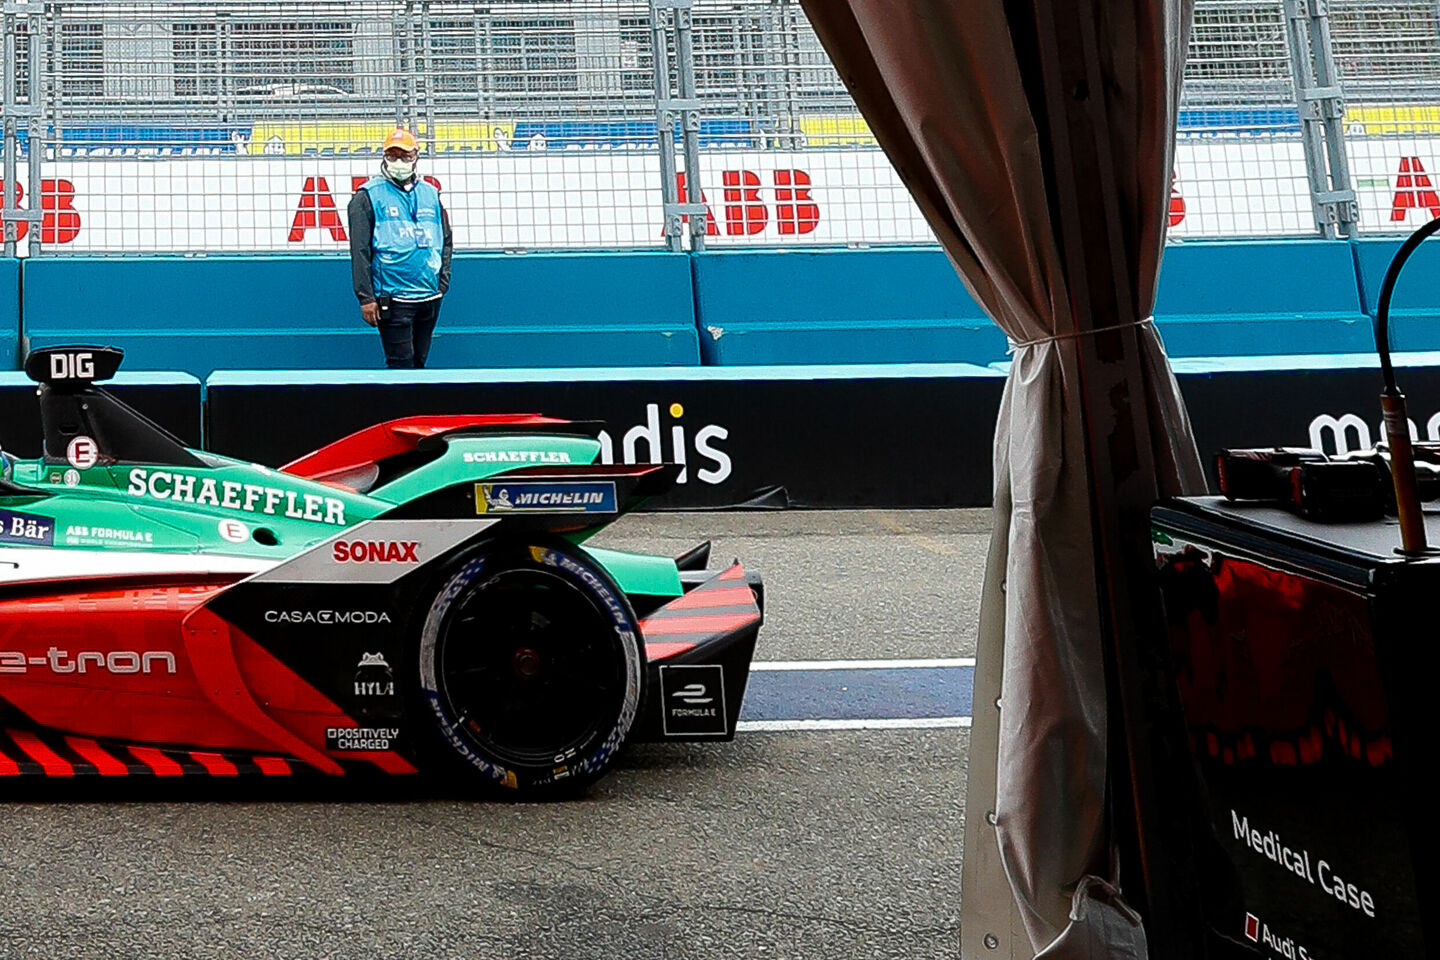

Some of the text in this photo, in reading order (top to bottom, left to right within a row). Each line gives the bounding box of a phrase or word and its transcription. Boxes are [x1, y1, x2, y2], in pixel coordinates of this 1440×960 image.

[50, 353, 95, 379] DIG
[74, 442, 90, 463] E
[463, 451, 571, 463] SCHAEFFLER
[127, 468, 346, 526] SCHAEFFLER
[515, 492, 604, 505] MICHELIN
[10, 516, 50, 540] Bär
[91, 527, 144, 541] FORMULA
[226, 523, 243, 539] E
[333, 541, 420, 563] SONAX
[354, 681, 395, 696] HYLA
[671, 708, 710, 717] FORMULA
[337, 728, 399, 739] POSITIVELY
[338, 739, 390, 749] CHARGED
[1231, 808, 1376, 918] Medical Case
[1262, 923, 1297, 960] Audi
